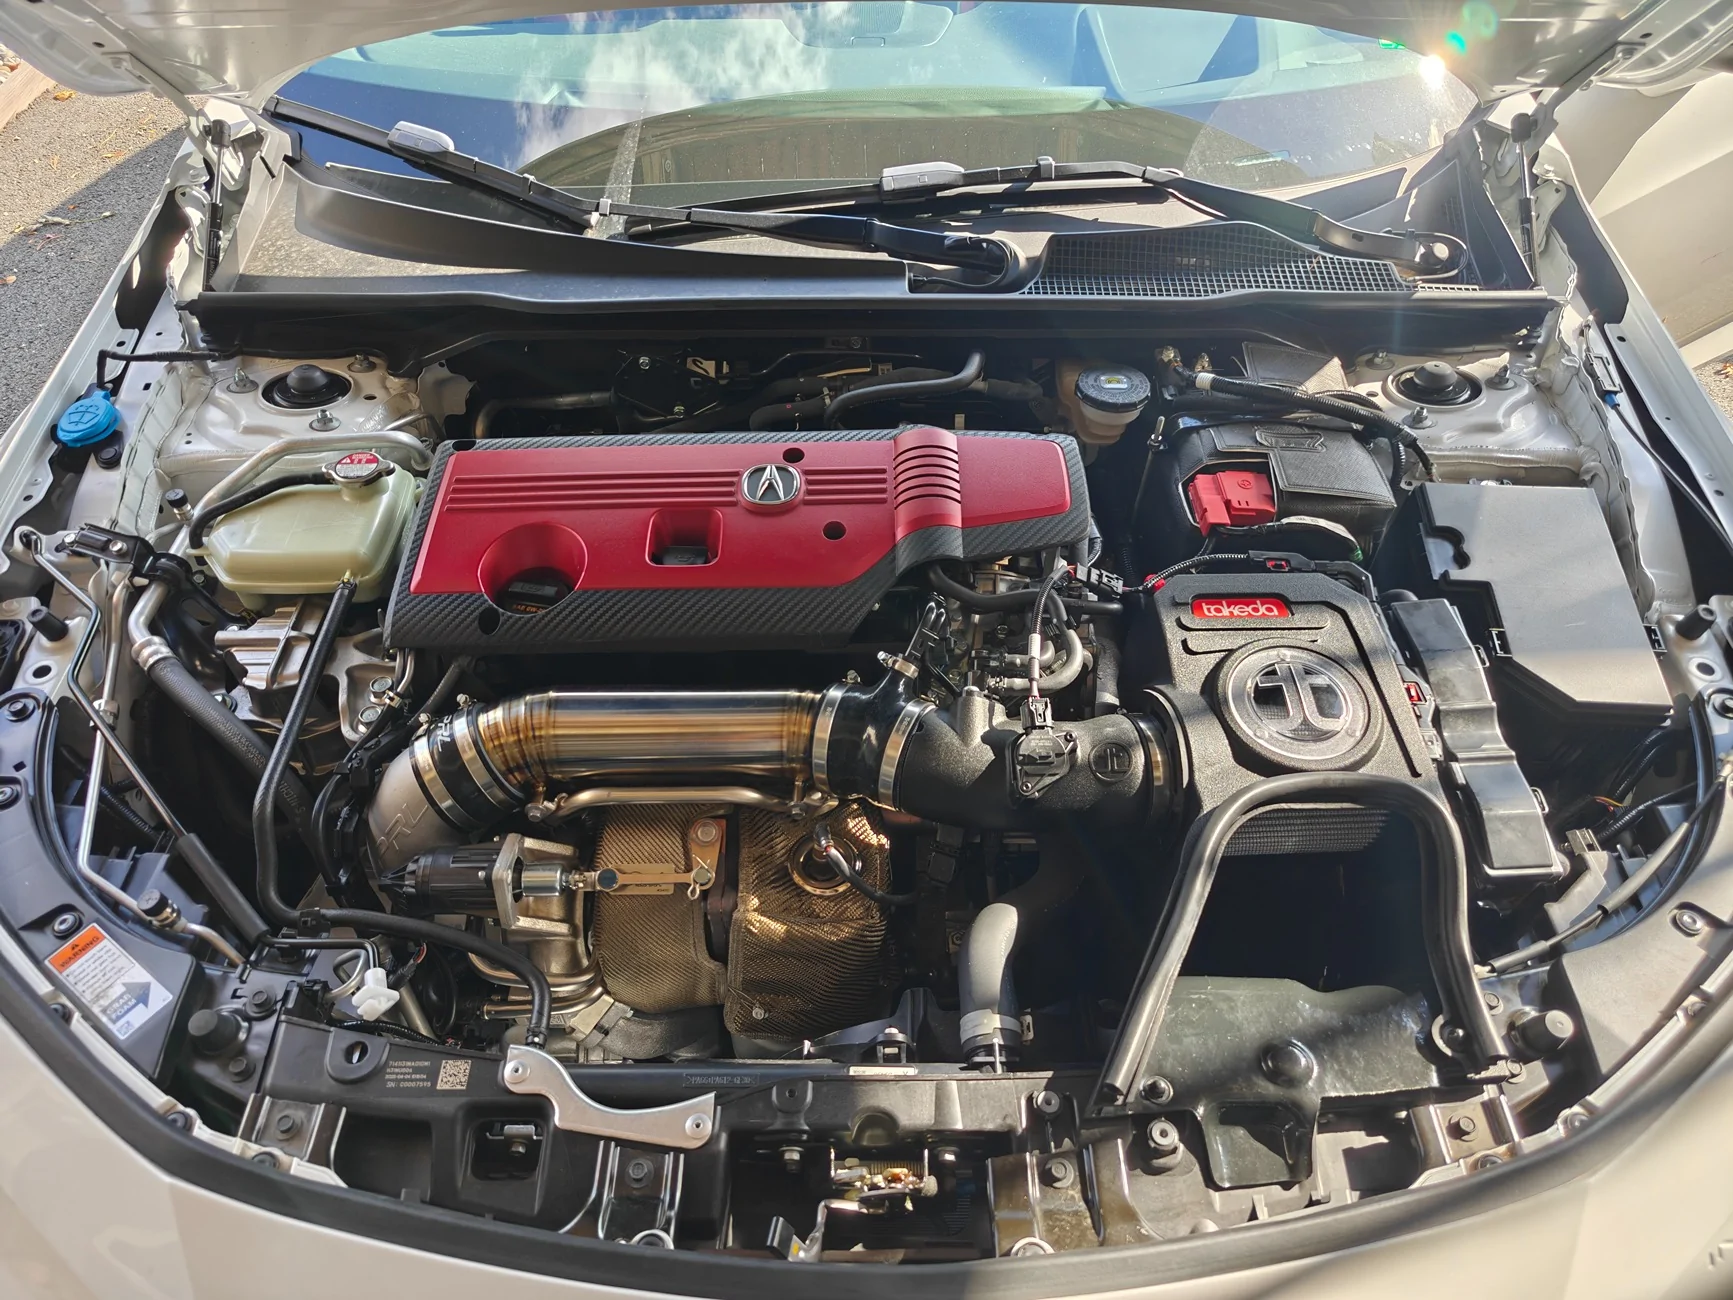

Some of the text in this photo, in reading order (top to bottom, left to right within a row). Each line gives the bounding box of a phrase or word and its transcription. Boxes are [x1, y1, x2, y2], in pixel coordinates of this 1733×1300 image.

[1202, 600, 1278, 617] takeda
[59, 935, 100, 968] WARNING
[105, 992, 132, 1015] GRAB
[110, 997, 137, 1021] FOAM
